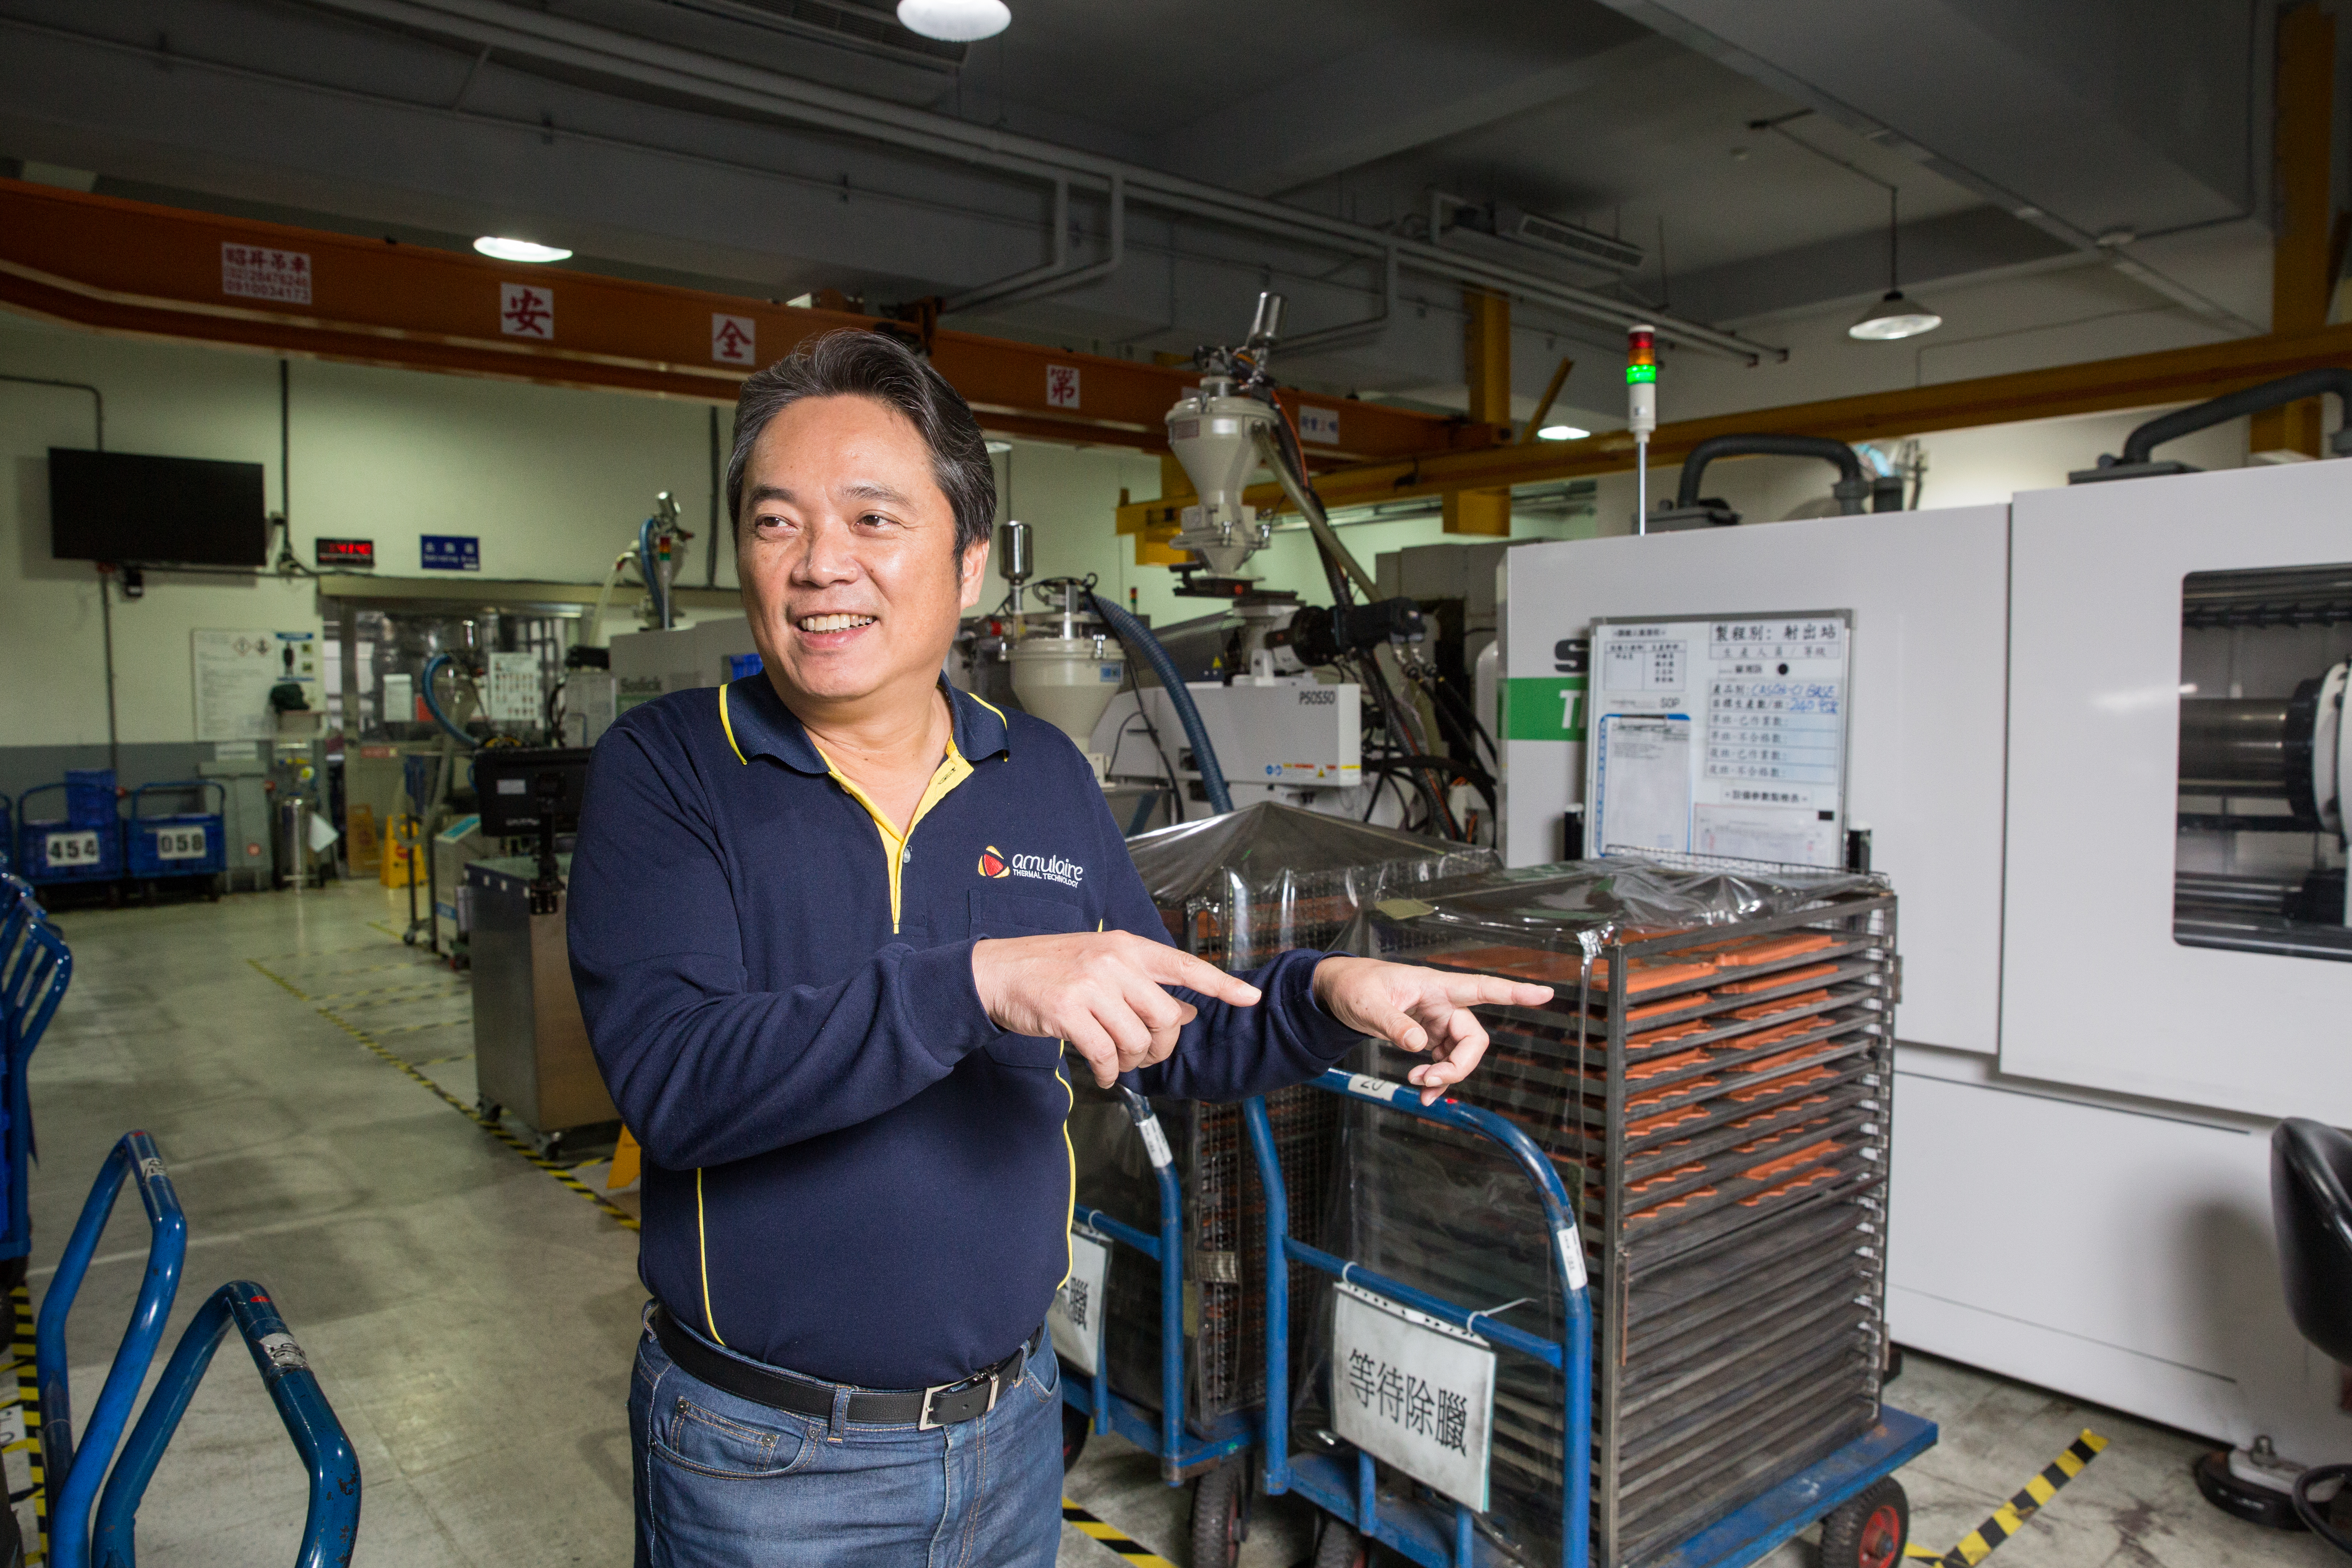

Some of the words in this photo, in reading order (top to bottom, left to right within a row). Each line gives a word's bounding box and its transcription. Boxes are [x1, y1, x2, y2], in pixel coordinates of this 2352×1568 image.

[504, 287, 552, 335] 安
[715, 318, 752, 359] 全
[1012, 853, 1083, 881] amulaire
[1013, 869, 1042, 879] THERMAL
[1042, 873, 1078, 888] TECHNOLOGY
[1349, 1348, 1467, 1457] 等待除臘
